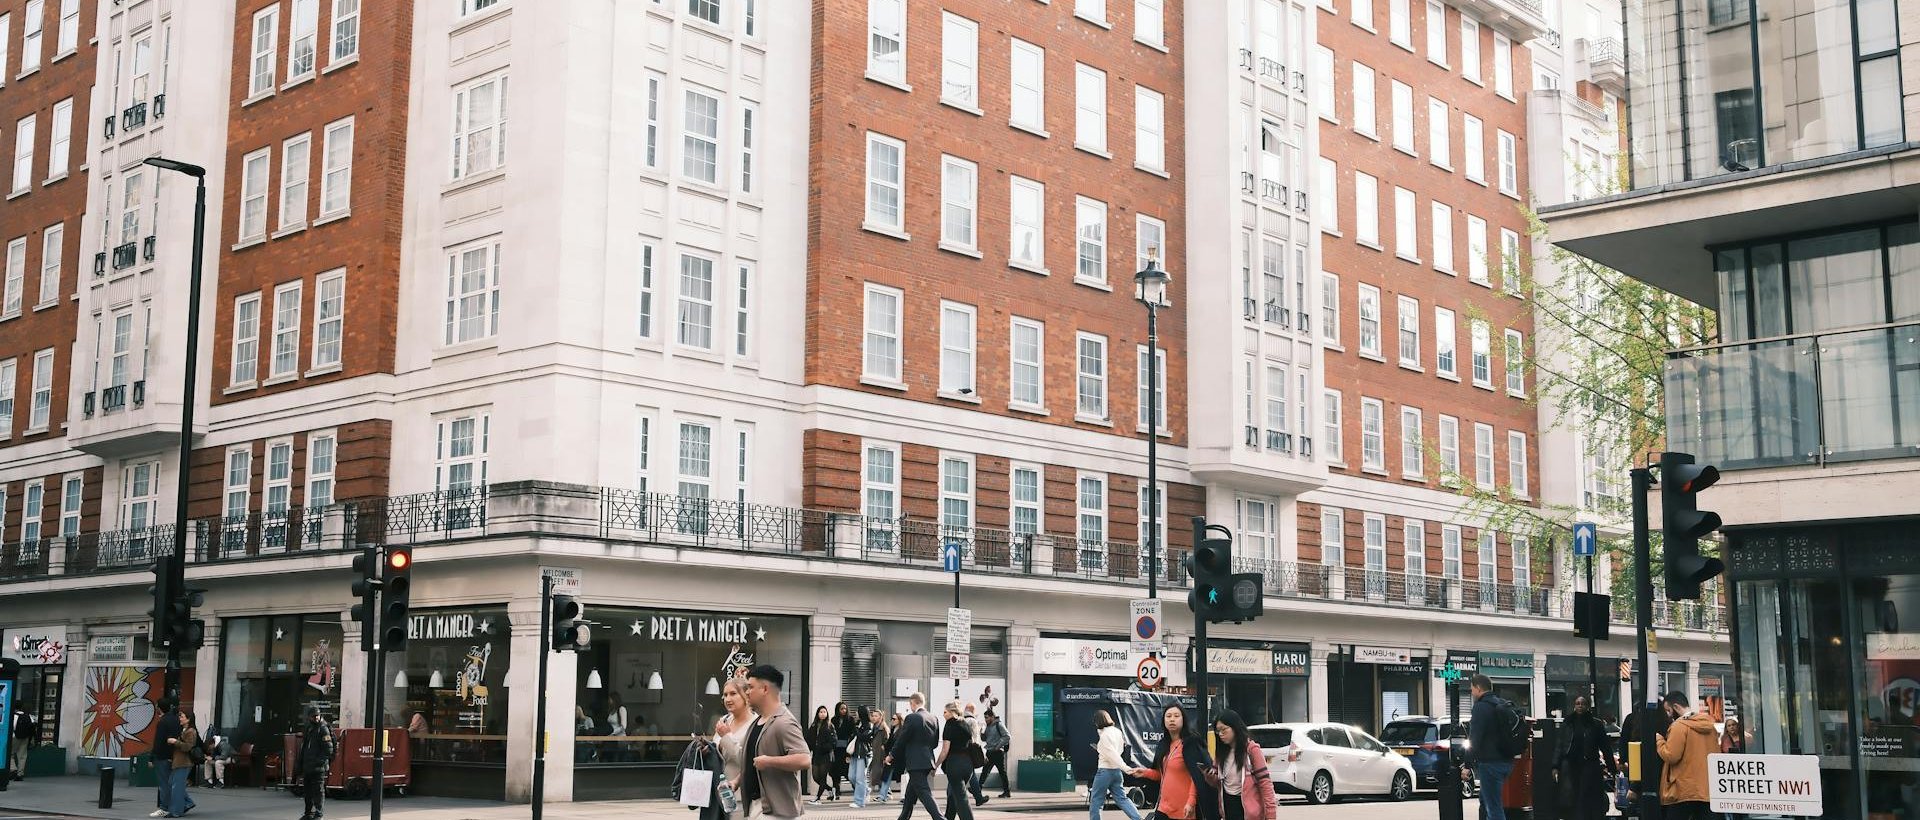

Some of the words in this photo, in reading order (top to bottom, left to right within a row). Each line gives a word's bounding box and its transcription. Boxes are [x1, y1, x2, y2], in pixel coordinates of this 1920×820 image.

[543, 569, 575, 578] MELCOMBE
[567, 579, 579, 587] NW1
[407, 616, 424, 639] RET
[426, 617, 433, 639] A
[436, 614, 474, 639] MANGER
[651, 616, 681, 641] PRET
[686, 619, 694, 641] A
[699, 619, 748, 643] MANGER
[1095, 648, 1128, 661] Optimal
[1274, 653, 1306, 666] HARU
[726, 664, 735, 681] Goo
[1141, 667, 1159, 680] 20
[1717, 760, 1766, 776] BAKER
[1718, 778, 1773, 795] STREET
[1778, 780, 1811, 796] NW1
[1719, 802, 1734, 810] CITY
[1746, 803, 1796, 812] WESTMINSTER
